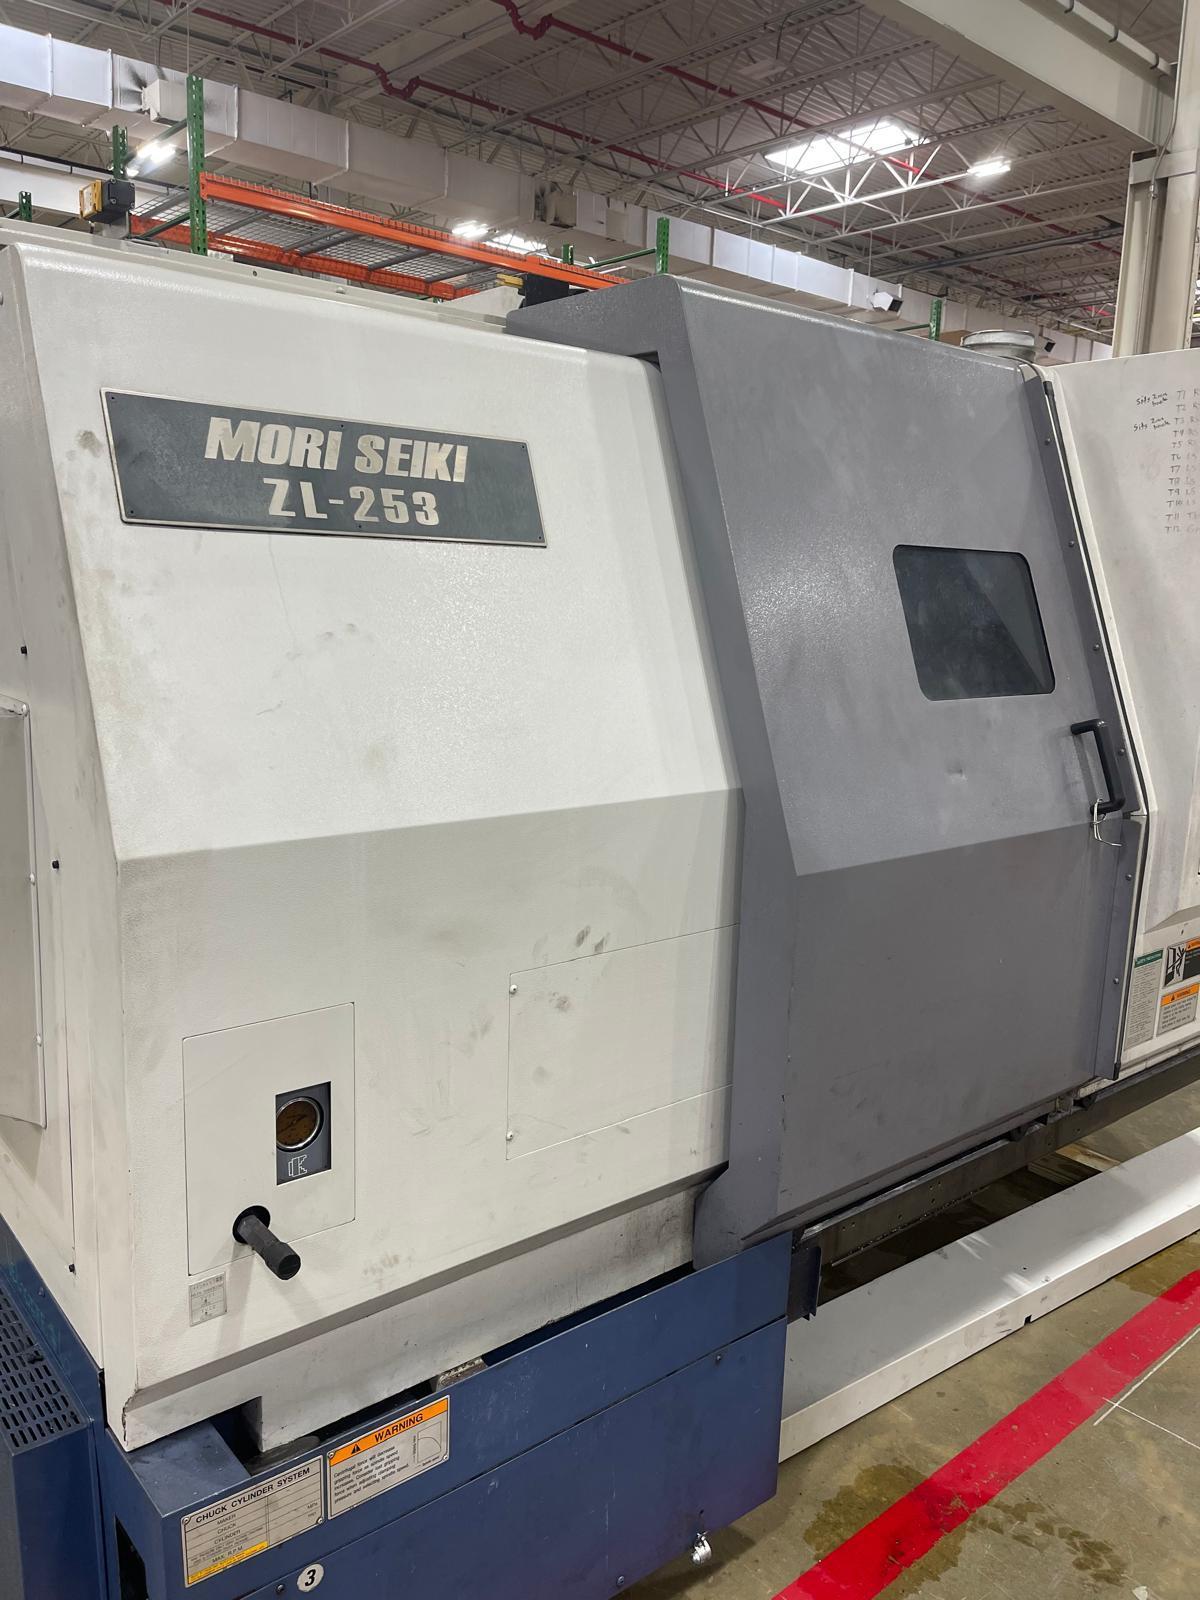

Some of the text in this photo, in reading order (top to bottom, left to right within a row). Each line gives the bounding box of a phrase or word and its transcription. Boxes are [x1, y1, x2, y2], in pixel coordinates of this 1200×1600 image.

[204, 416, 469, 483] MORI SEIKI
[1170, 464, 1181, 473] T7
[1168, 488, 1180, 497] T9
[263, 477, 440, 526] ZL-253
[374, 1413, 424, 1442] WARNING
[195, 1467, 310, 1523] CHUCK CYLINDER SYSTEM
[217, 1514, 236, 1525] MAKER
[217, 1522, 236, 1534] CHUCK
[214, 1529, 241, 1545] CYLINDER
[304, 1568, 316, 1587] 3
